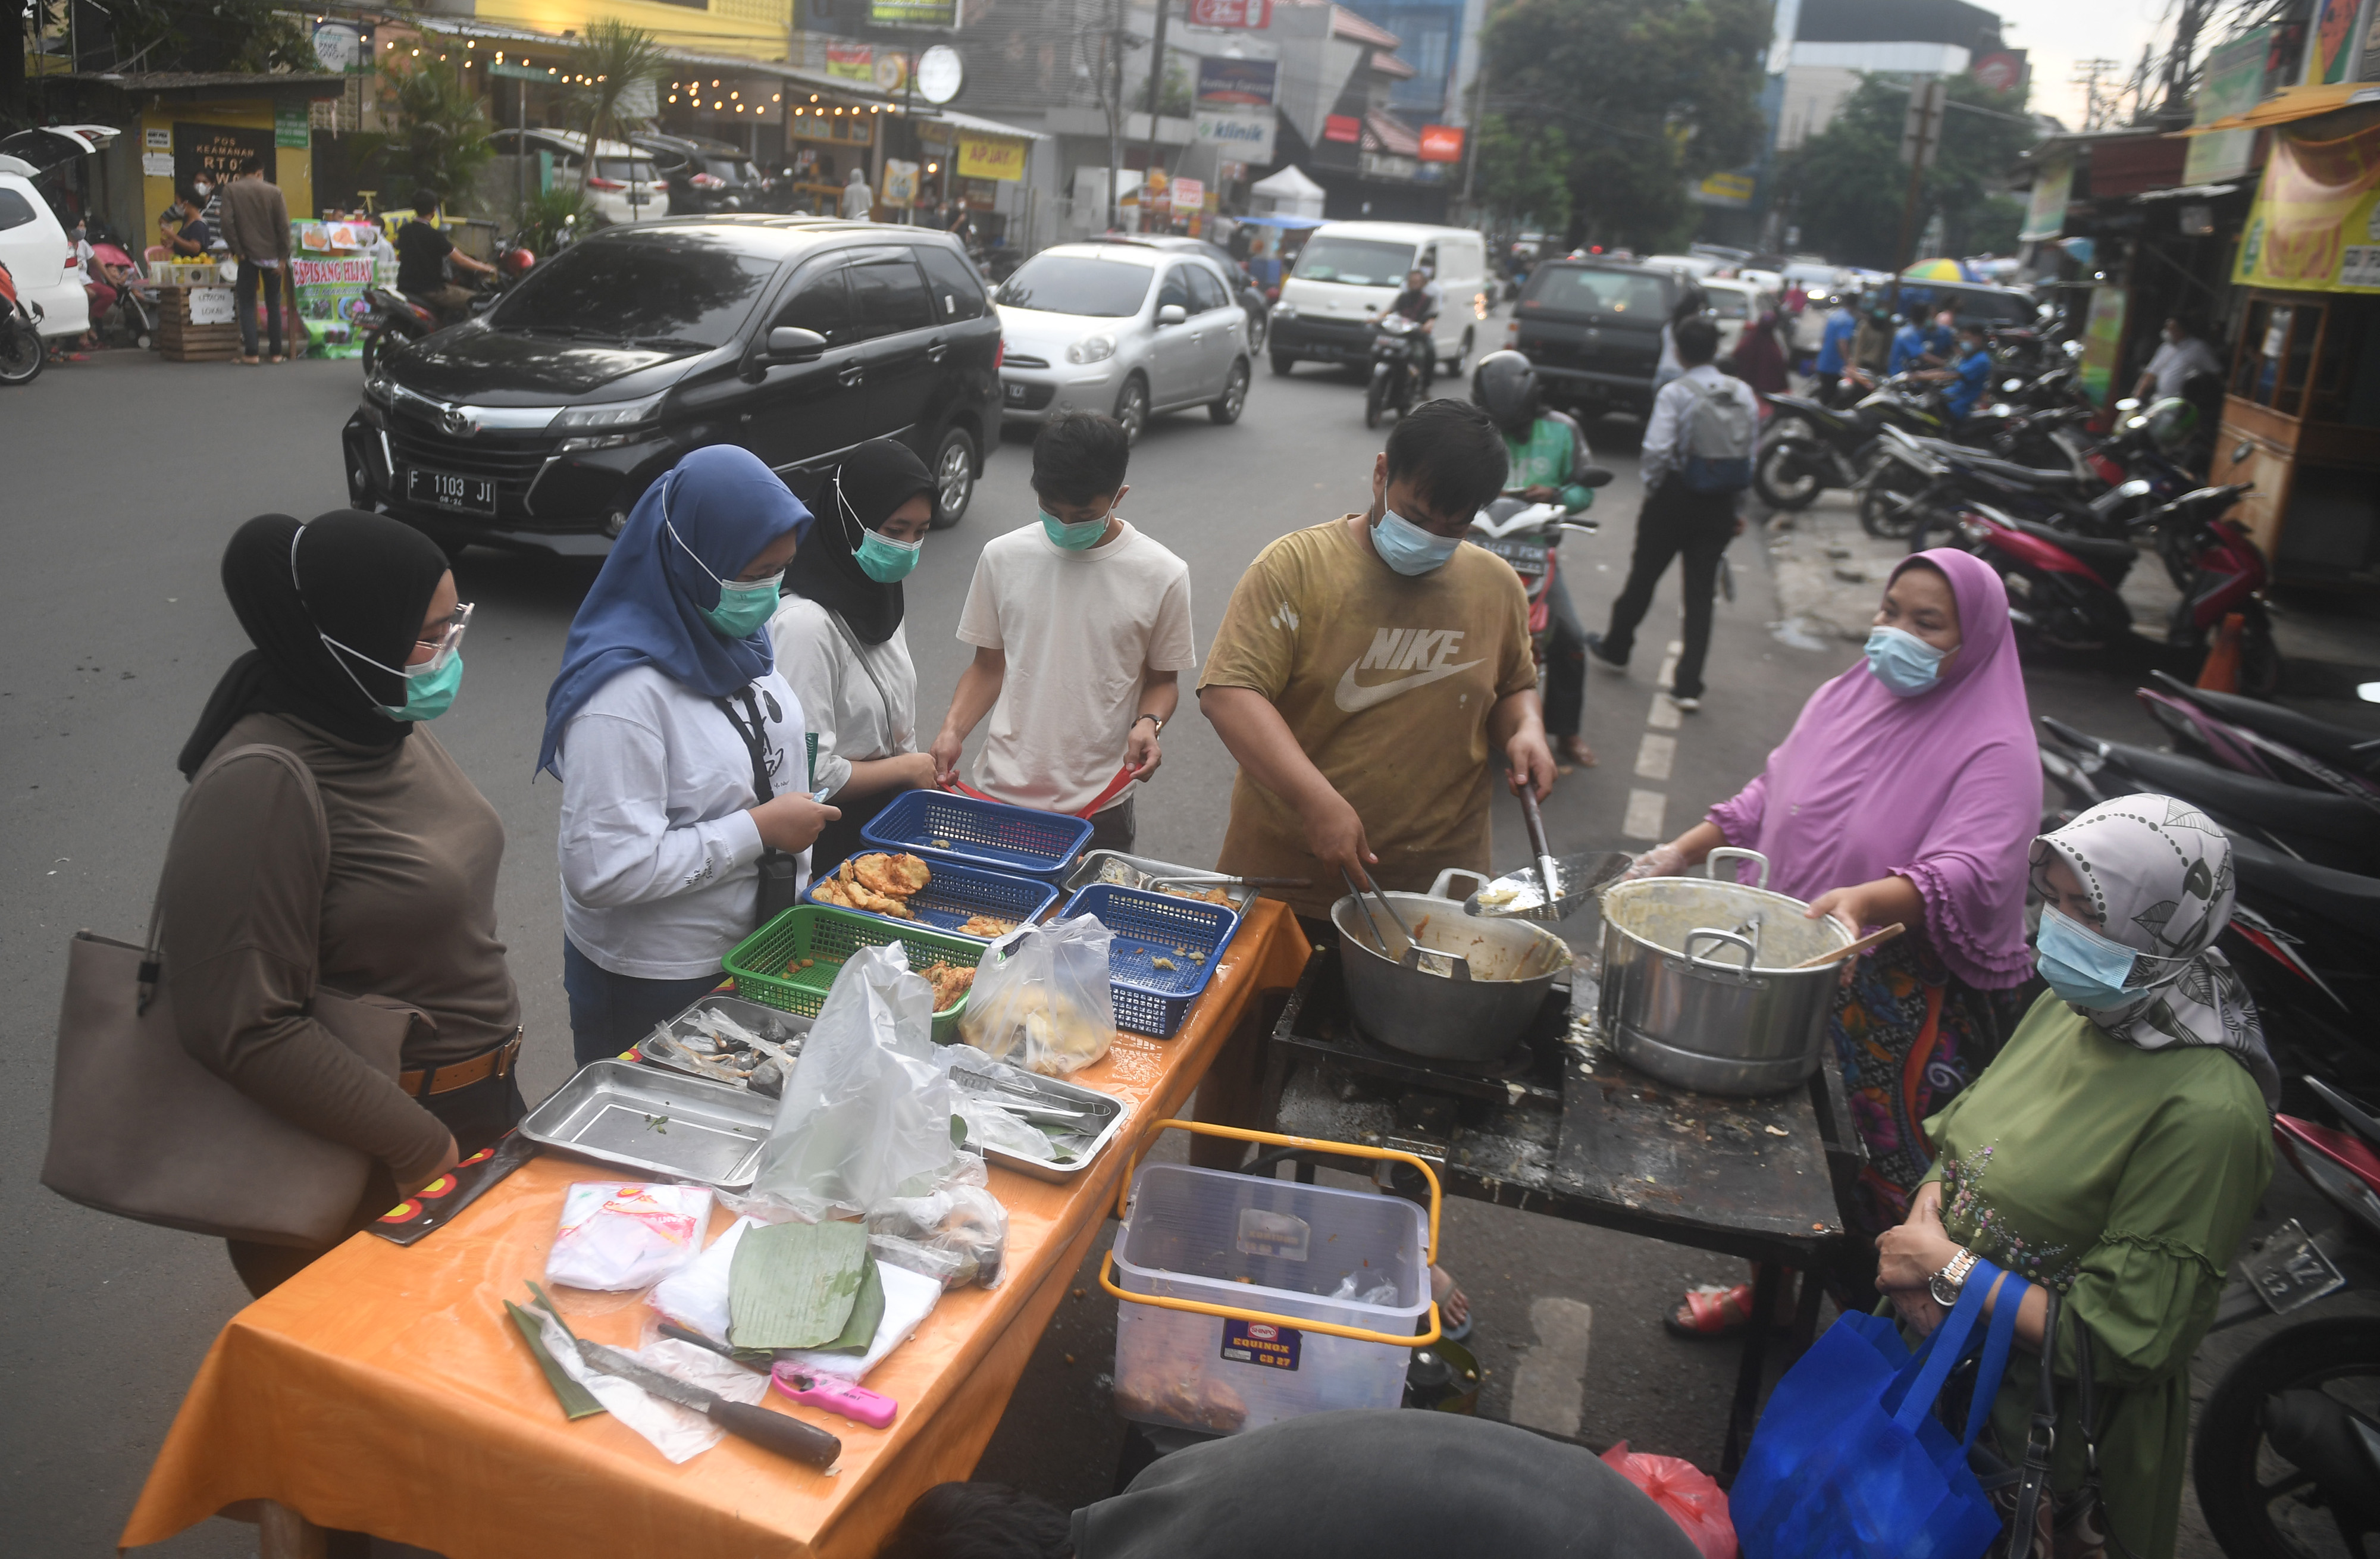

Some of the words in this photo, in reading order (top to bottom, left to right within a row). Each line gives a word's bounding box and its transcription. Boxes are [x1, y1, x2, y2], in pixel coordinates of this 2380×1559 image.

[1214, 120, 1264, 142] klinik
[214, 136, 236, 147] POS
[196, 145, 255, 158] KEAMANAN
[411, 471, 418, 489] F
[435, 475, 464, 497] 1103
[477, 483, 490, 502] JI
[1360, 628, 1464, 671] NIKE
[1251, 1326, 1276, 1336] SHINPO
[1233, 1337, 1290, 1354] EQUINOX
[1276, 1357, 1291, 1367] 27
